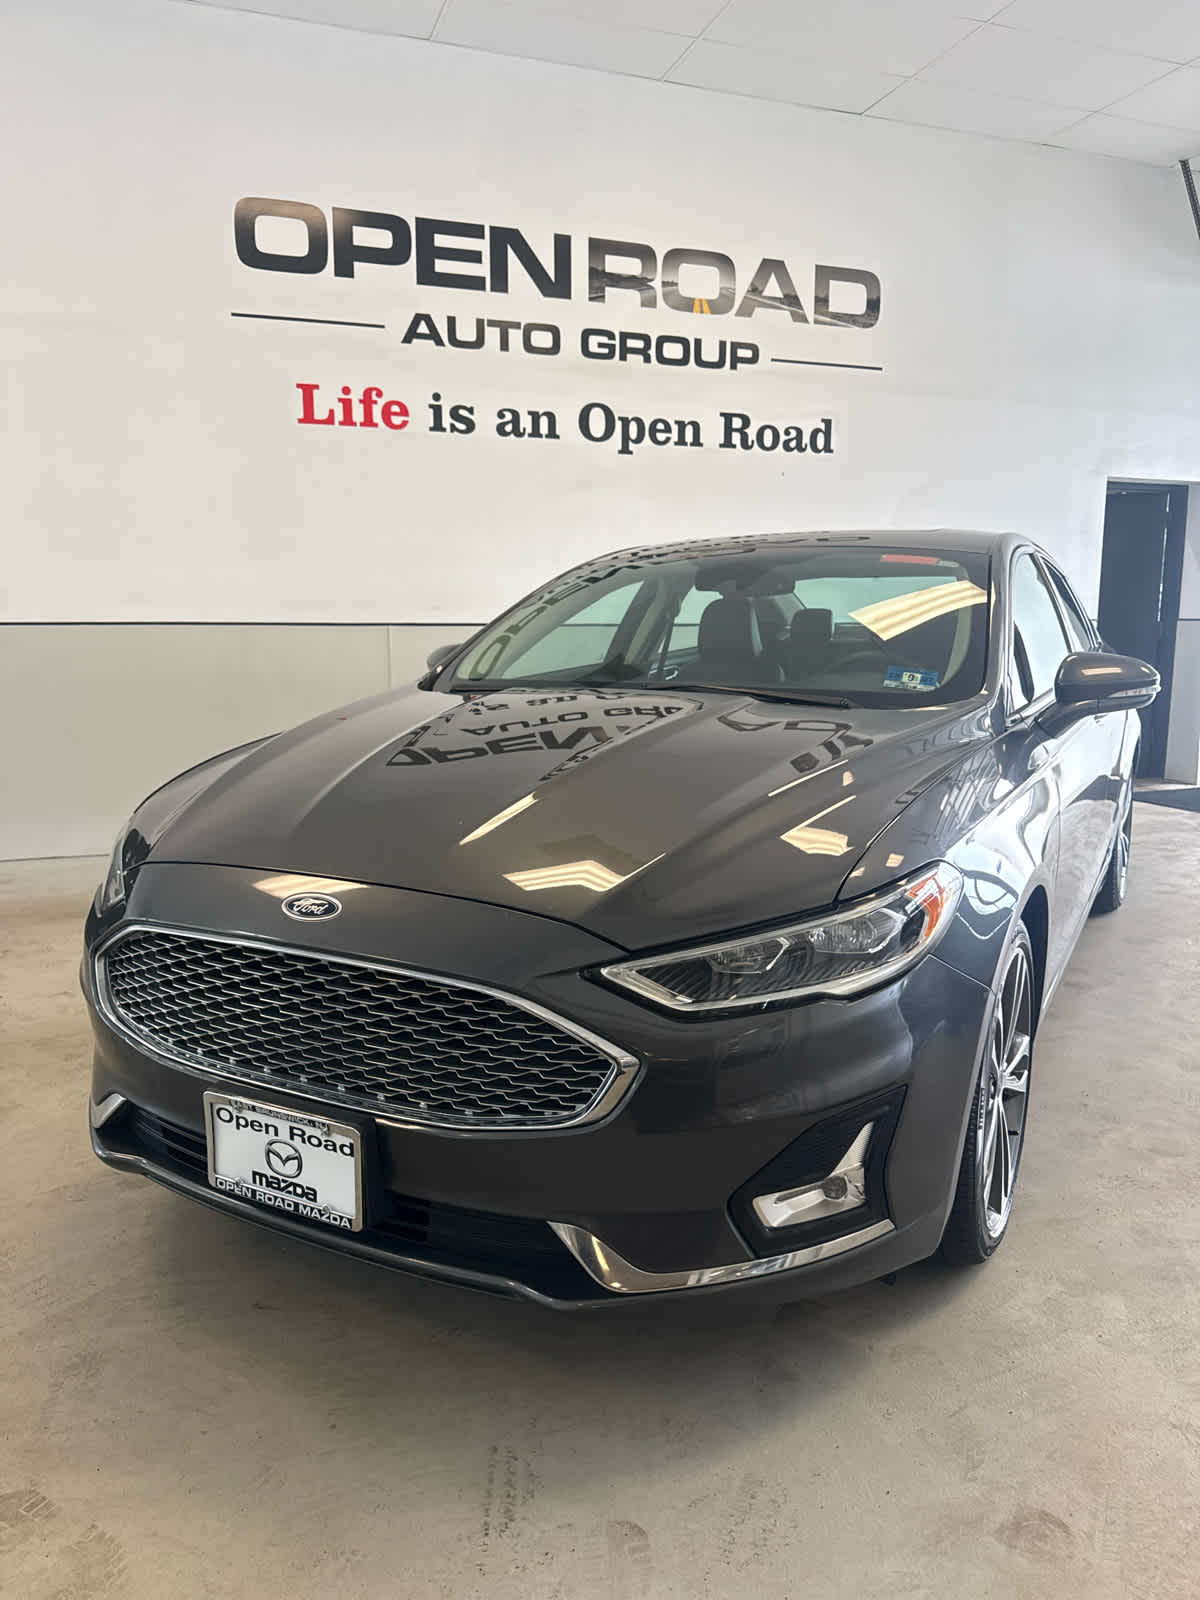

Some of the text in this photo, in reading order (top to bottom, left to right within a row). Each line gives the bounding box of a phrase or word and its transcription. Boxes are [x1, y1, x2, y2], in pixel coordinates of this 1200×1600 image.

[234, 197, 881, 329] OPEN ROAD
[401, 312, 760, 371] AUTO GROUP
[296, 383, 834, 456] Life is an Open Road
[292, 898, 329, 915] Ford
[216, 1107, 279, 1137] Open
[289, 1125, 355, 1158] Road
[215, 1177, 352, 1229] OPEN ROAD MAZDA
